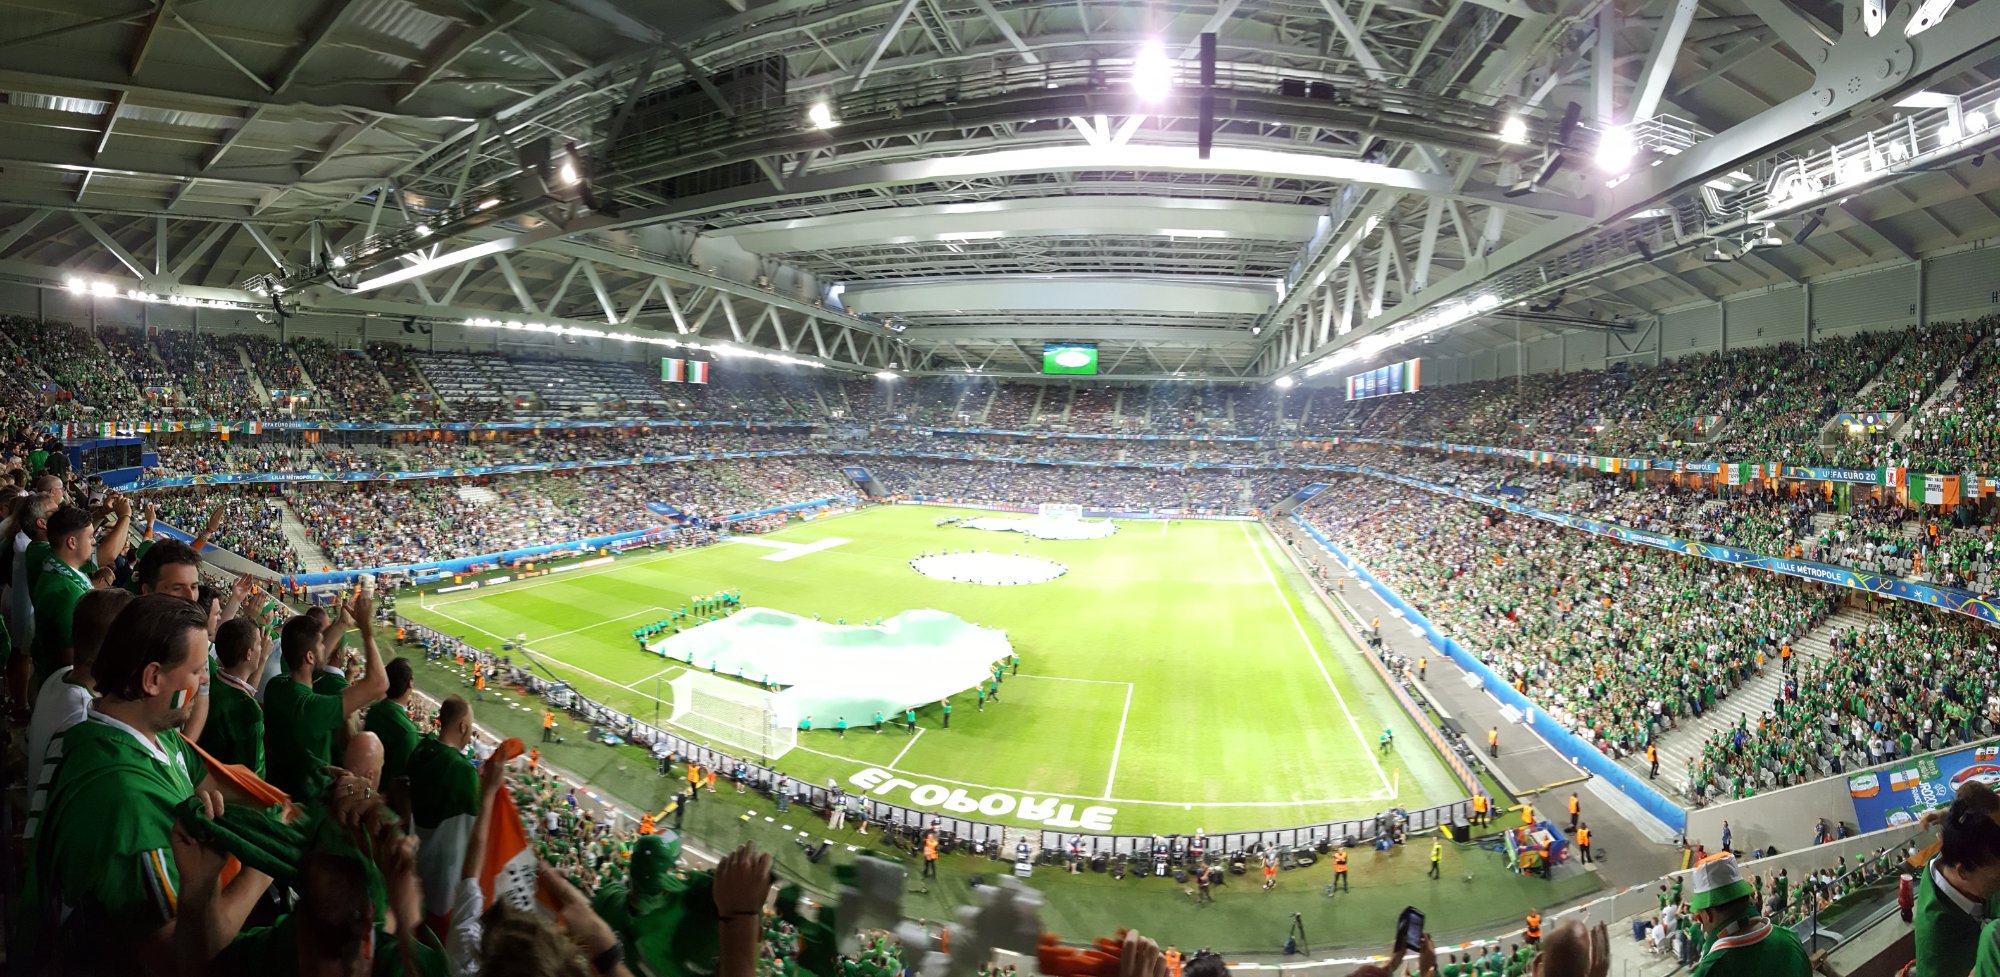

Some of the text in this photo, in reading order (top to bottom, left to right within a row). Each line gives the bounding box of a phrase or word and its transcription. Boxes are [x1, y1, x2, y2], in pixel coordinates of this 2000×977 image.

[1843, 471, 1864, 480] EURO
[1865, 473, 1877, 481] 20
[1776, 561, 1842, 581] LILLE MÉTROPOLE
